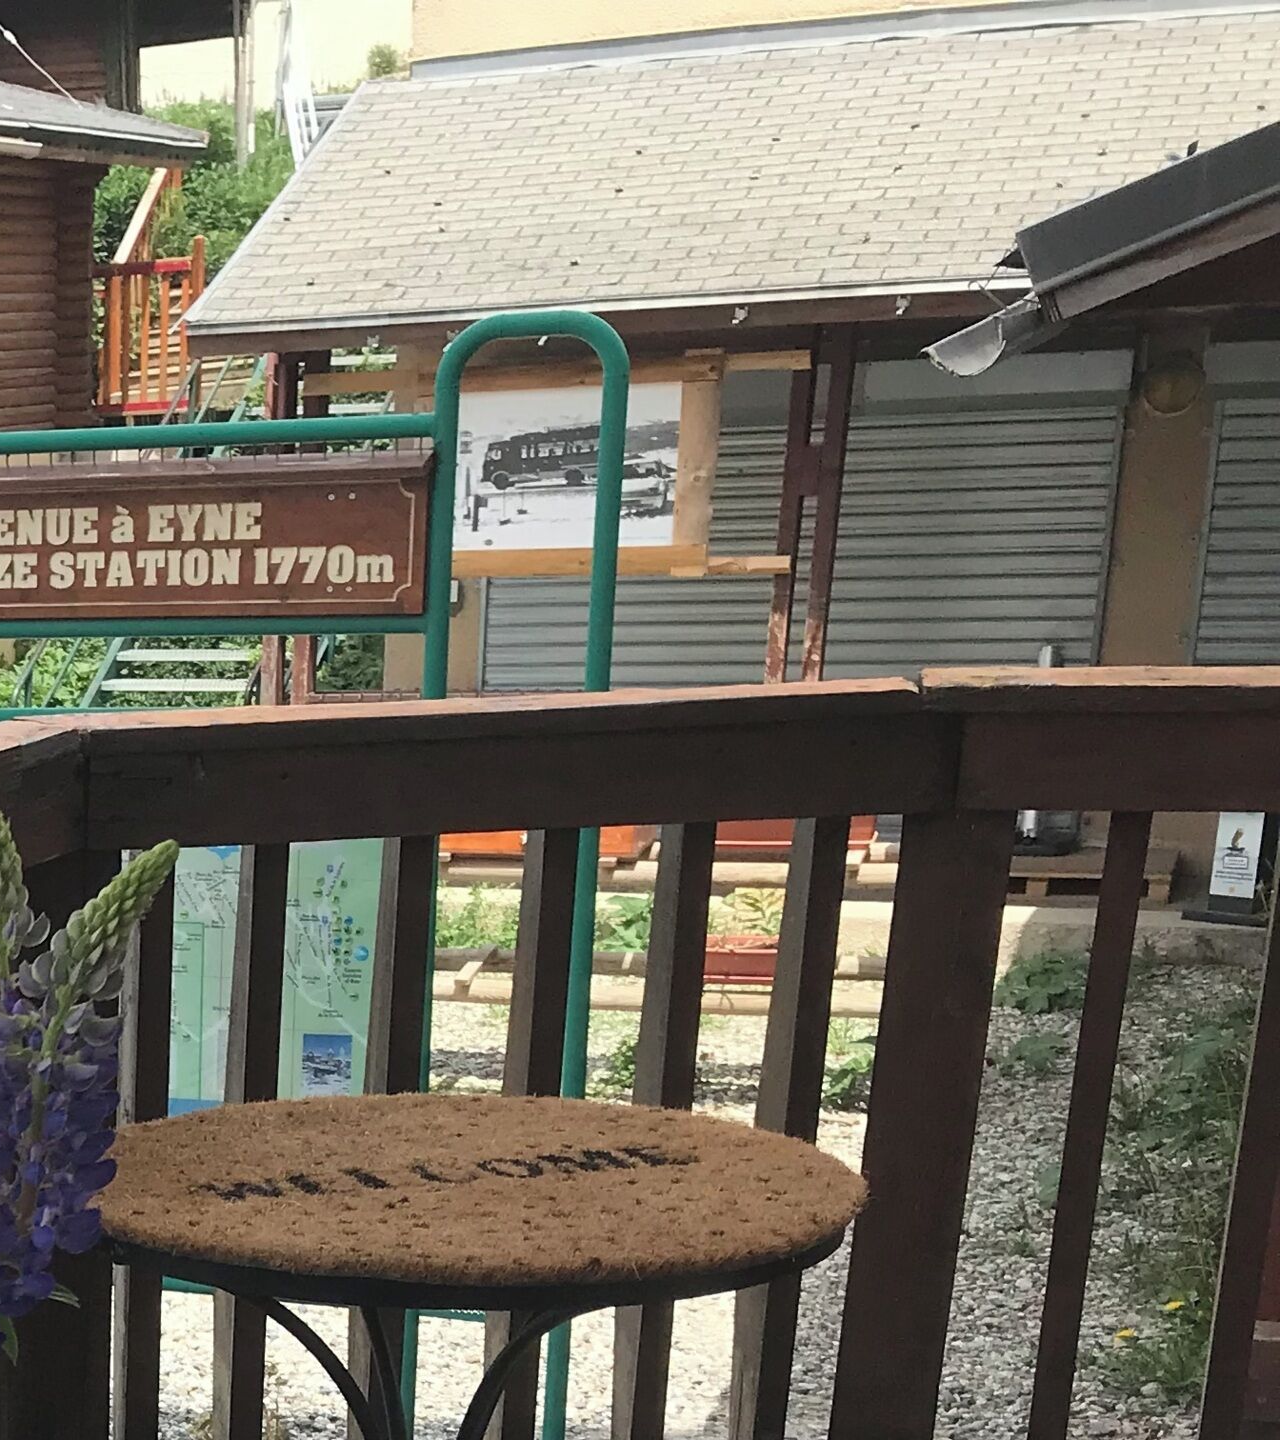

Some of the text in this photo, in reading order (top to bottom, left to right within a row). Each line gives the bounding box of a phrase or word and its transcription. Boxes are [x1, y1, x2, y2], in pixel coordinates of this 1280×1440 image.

[110, 506, 135, 544] à
[146, 502, 262, 543] EYNE
[49, 547, 242, 590] STATION
[253, 544, 395, 588] 1770m
